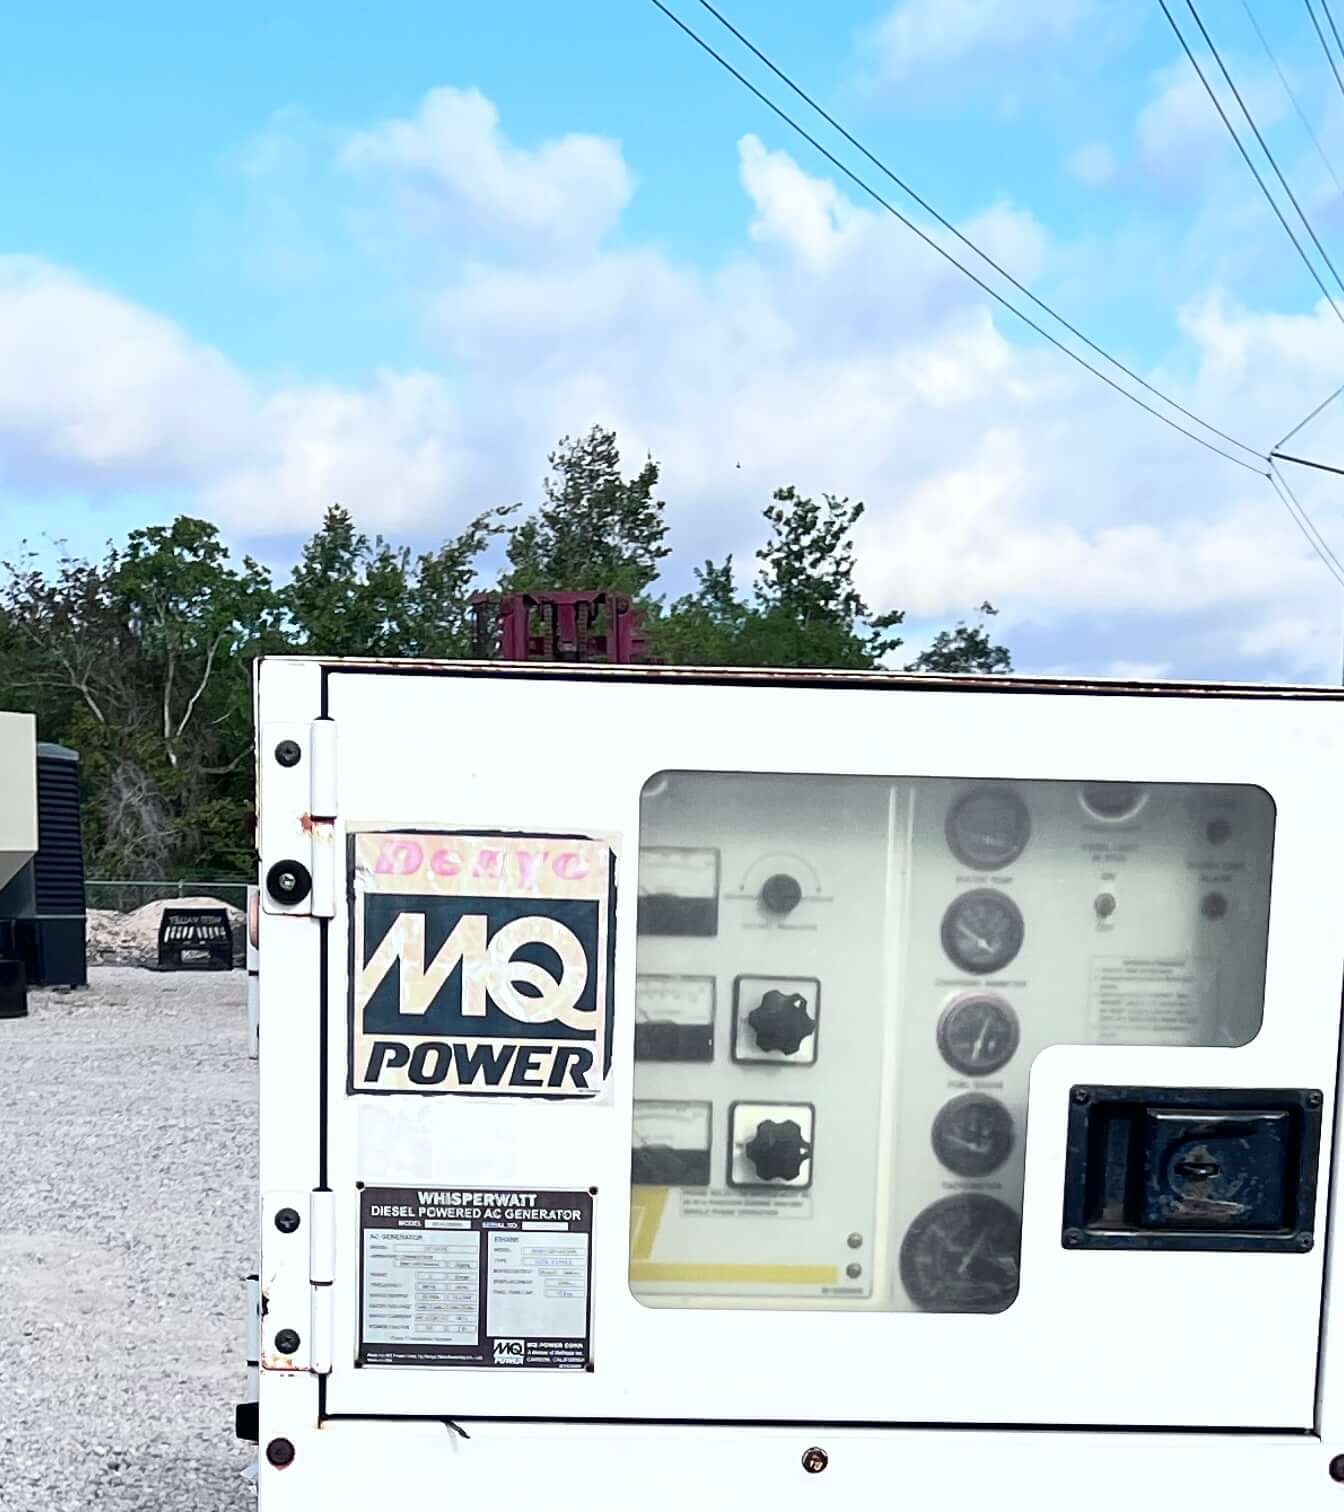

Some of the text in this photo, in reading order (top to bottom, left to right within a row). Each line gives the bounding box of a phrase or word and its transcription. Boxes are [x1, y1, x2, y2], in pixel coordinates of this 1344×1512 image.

[363, 912, 597, 1030] MQ
[363, 1041, 594, 1089] POWER
[418, 1191, 538, 1207] WHISPERWATT
[371, 1205, 581, 1221] DIESEL POWERED AC GENERATOR
[493, 1342, 524, 1355] MQ
